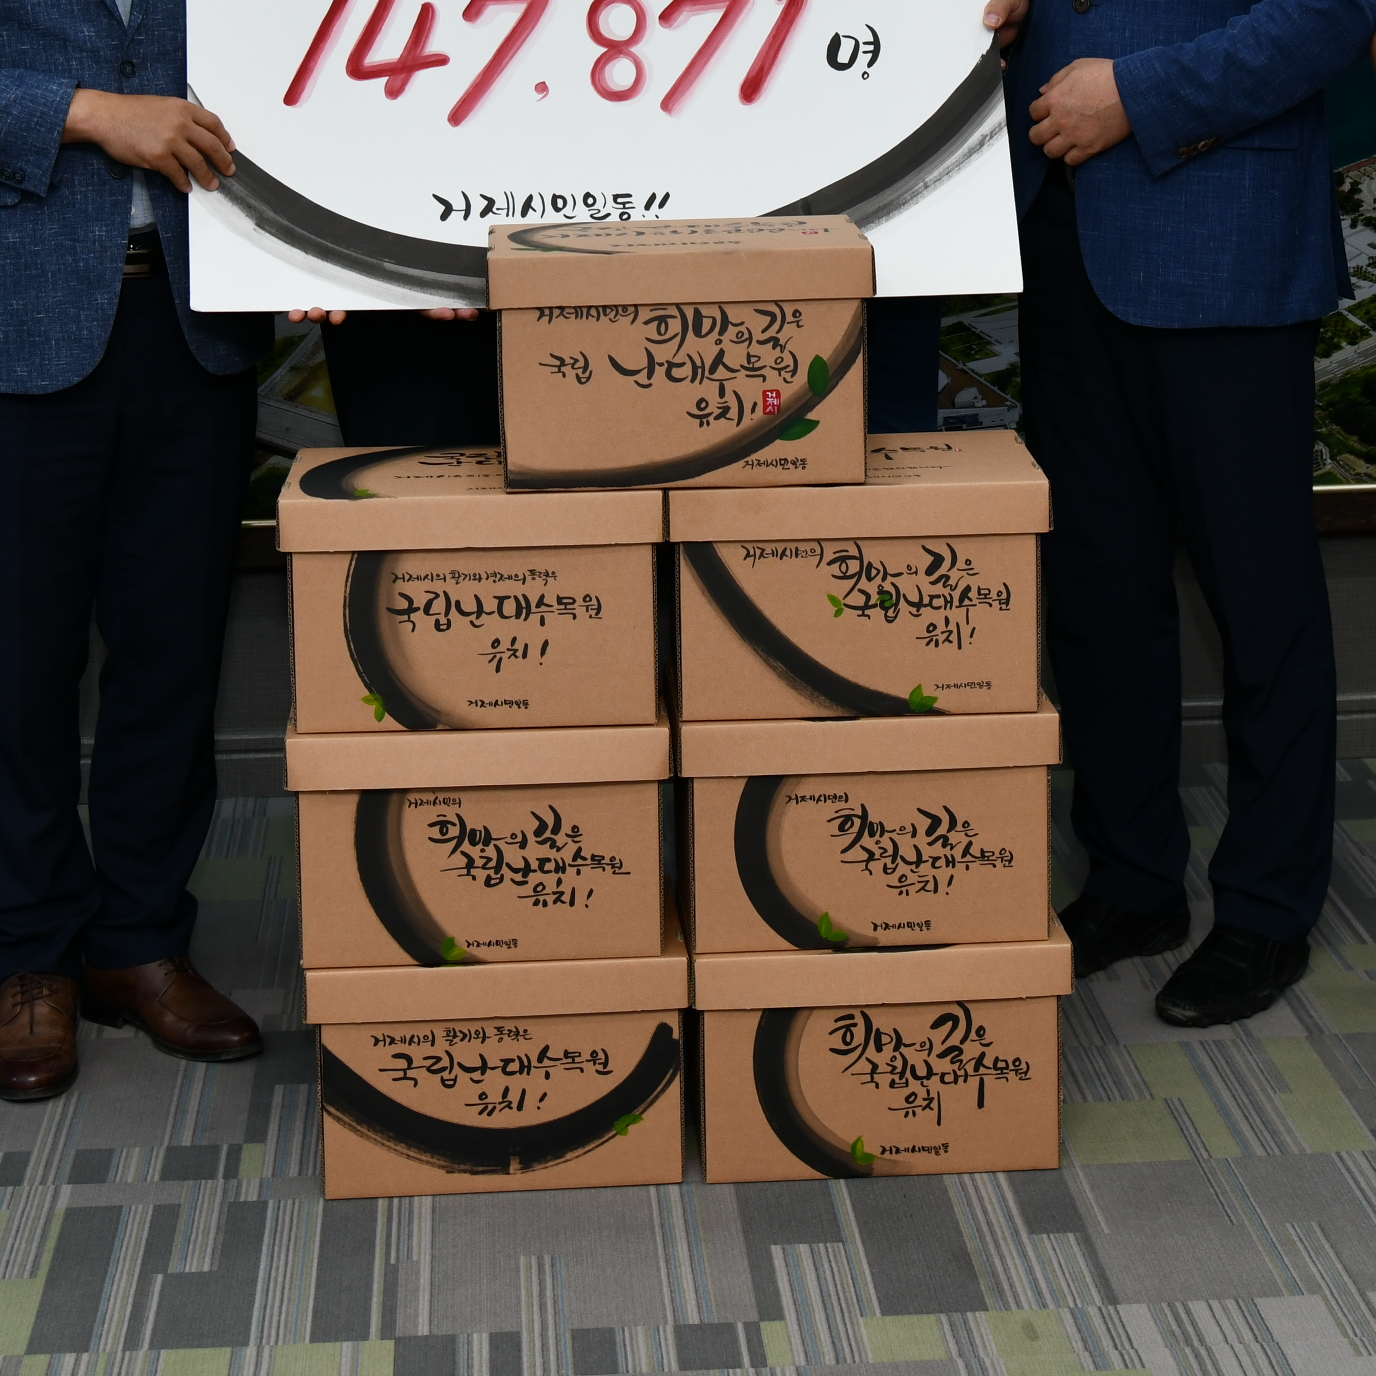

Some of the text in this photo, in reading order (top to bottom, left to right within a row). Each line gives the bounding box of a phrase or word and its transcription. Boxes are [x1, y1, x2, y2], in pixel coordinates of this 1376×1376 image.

[825, 24, 882, 80] 명
[535, 301, 805, 359] 거제시민의 희망의 길은
[538, 347, 799, 400] 국립 난대수목원
[765, 391, 780, 415] 거제시
[391, 571, 446, 584] 거제시의
[484, 571, 527, 585] 경제의
[740, 540, 980, 598] 거제시민의 희망의 길은
[406, 791, 462, 809] 거제시민의
[785, 792, 849, 805] 거제시민의
[427, 804, 583, 859] 희망의 길은
[826, 803, 979, 854] 희망의 길은
[370, 1025, 533, 1047] 거제시의 활기와 동력은
[929, 1001, 994, 1071] 길은
[887, 1088, 942, 1126] 유치
